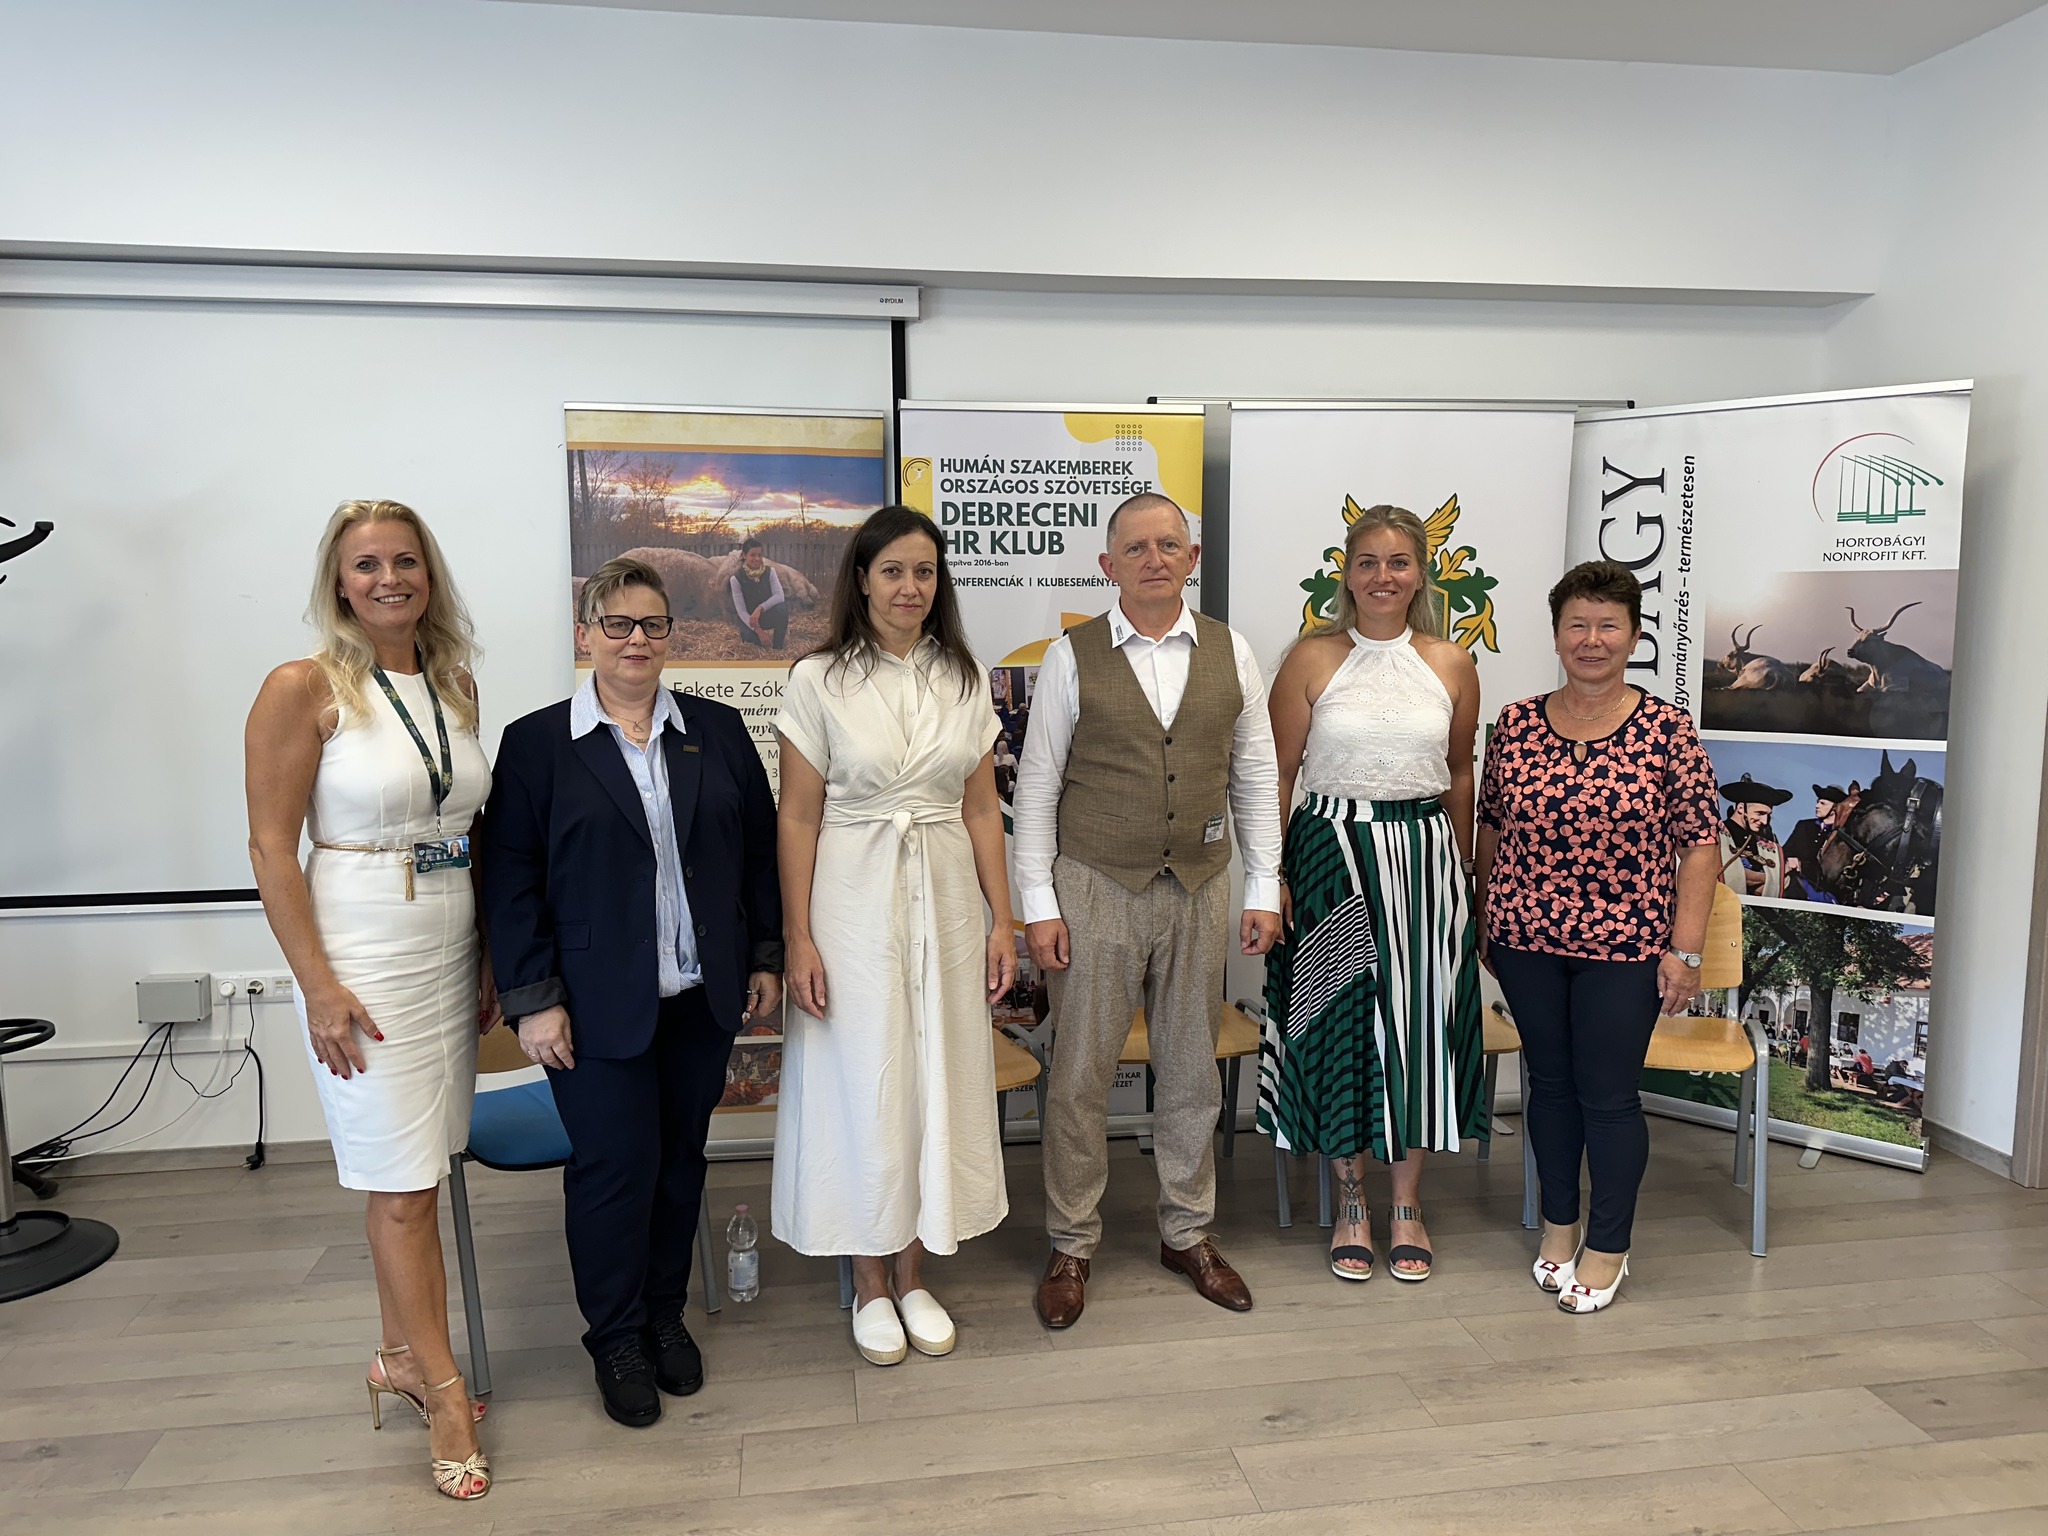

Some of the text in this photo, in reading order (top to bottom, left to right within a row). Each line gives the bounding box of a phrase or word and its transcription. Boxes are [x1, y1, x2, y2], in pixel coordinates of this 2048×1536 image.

[940, 454, 1134, 475] HUMÁN SZAKEMBEREK
[940, 474, 1153, 495] ORSZÁGOS SZÖVETSÉGE
[941, 501, 1098, 527] DEBRECENI
[1677, 455, 1696, 574] természetesen
[942, 530, 1065, 555] HR KLUB
[1836, 534, 1926, 548] HORTOBÁGYI
[1822, 550, 1927, 562] NONPROFIT KFT.
[951, 575, 1024, 587] ONFERENCIÁK
[673, 681, 735, 699] Fekete
[1125, 1071, 1141, 1079] KAR
